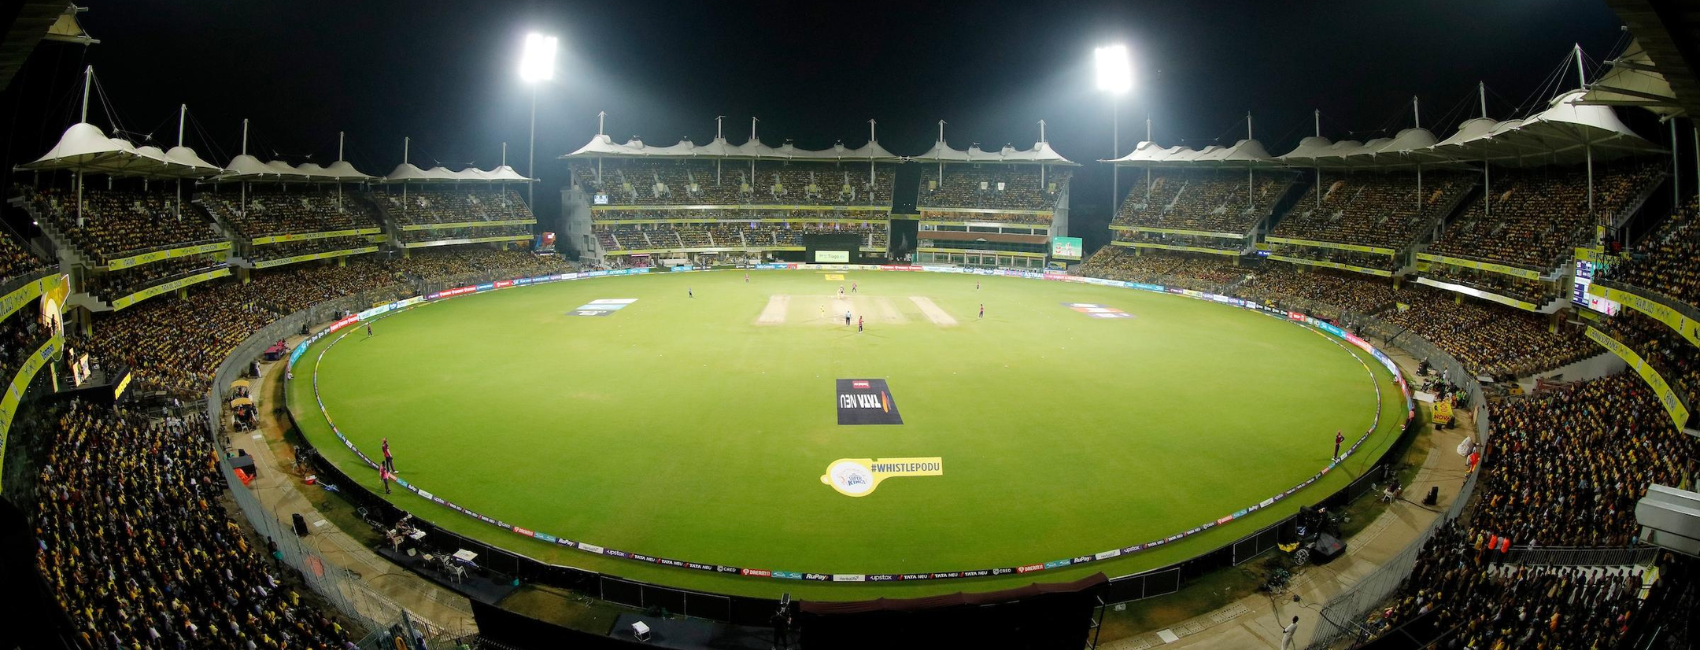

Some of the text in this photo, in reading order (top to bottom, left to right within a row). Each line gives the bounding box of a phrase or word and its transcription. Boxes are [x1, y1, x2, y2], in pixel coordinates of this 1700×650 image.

[840, 394, 882, 409] TATA NEU
[871, 462, 940, 473] #WHISTLEPODU
